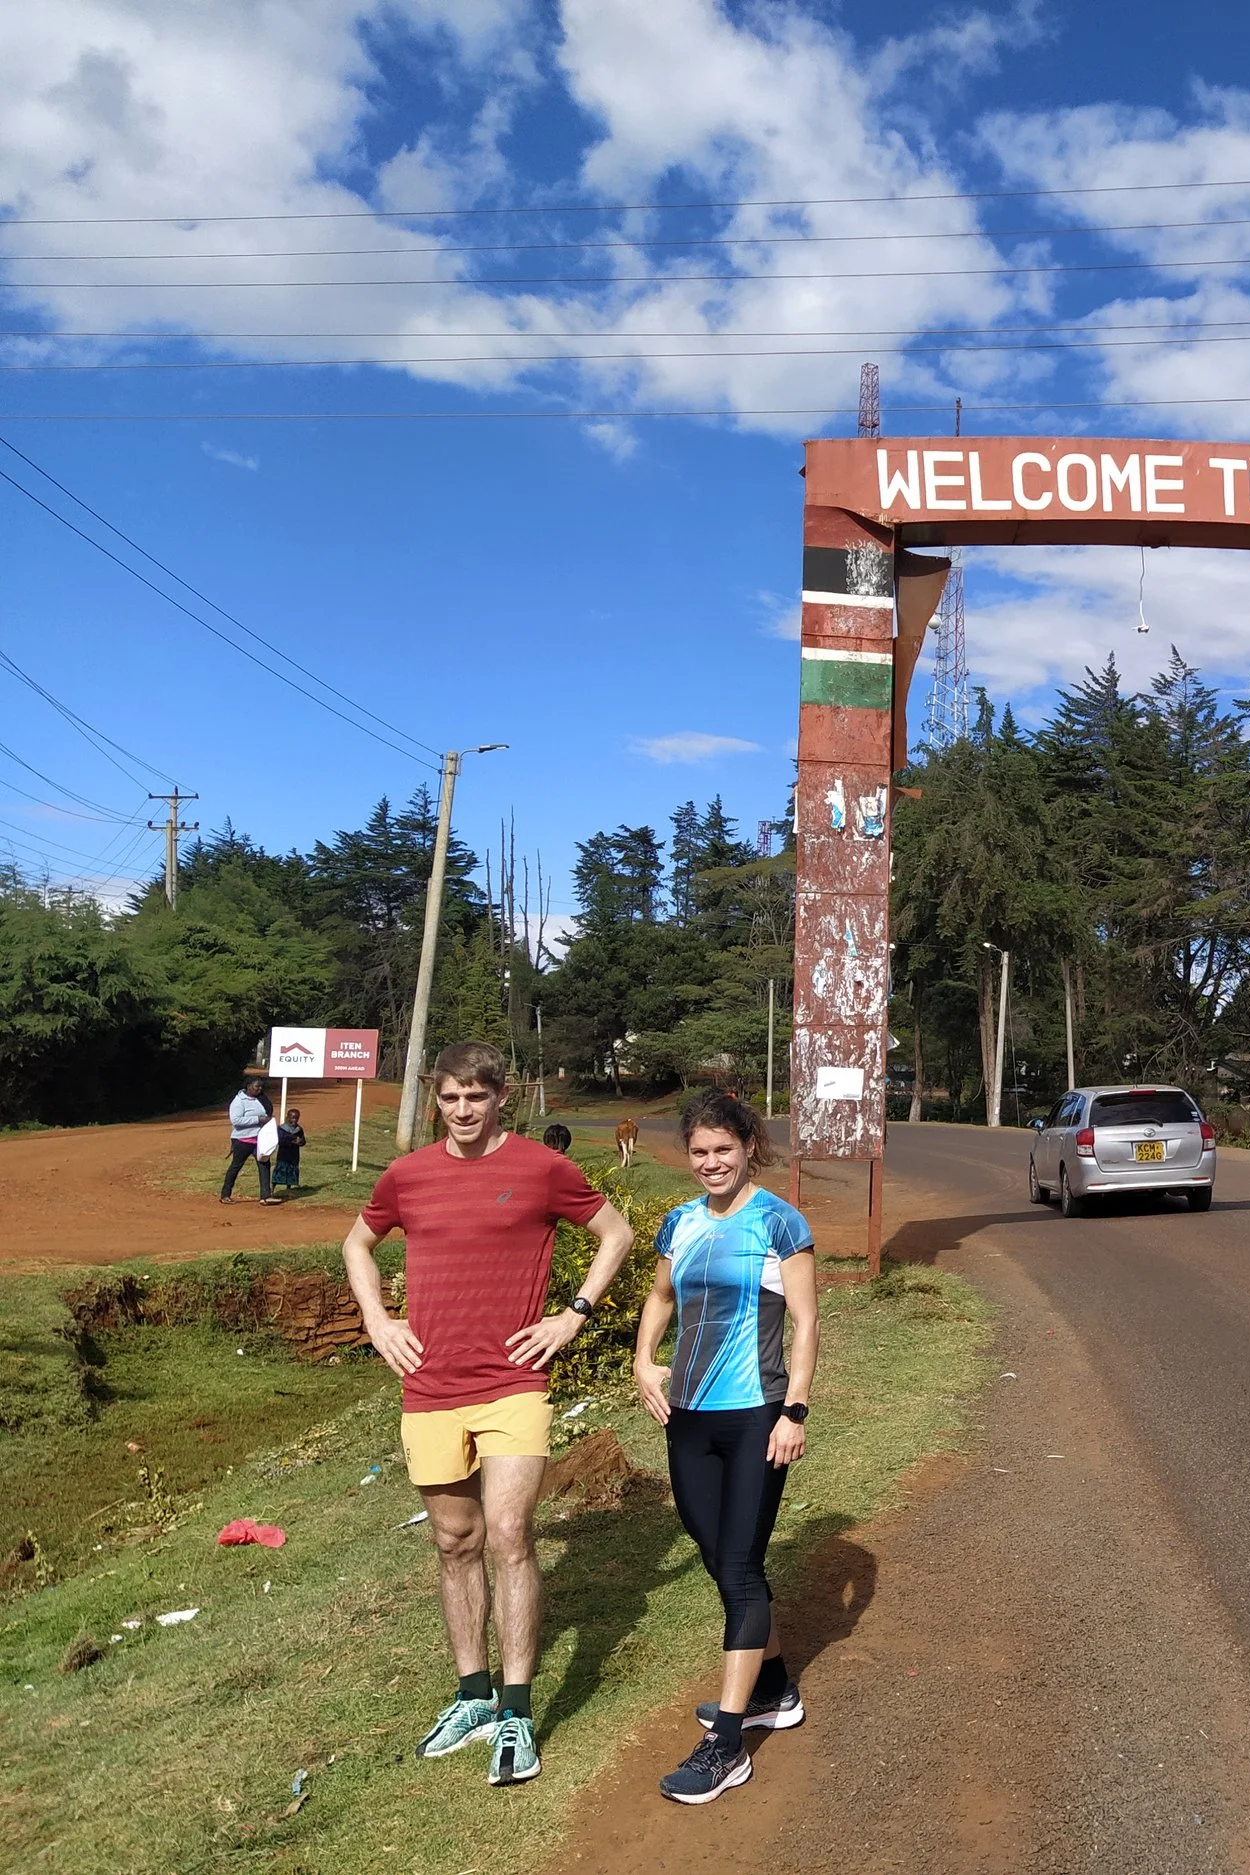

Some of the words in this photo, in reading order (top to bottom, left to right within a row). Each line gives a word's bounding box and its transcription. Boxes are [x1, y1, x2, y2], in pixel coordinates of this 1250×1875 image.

[876, 448, 1185, 514] WELCOME
[340, 1042, 362, 1050] ITEN
[331, 1050, 370, 1059] BRANCH
[279, 1055, 315, 1063] EQUITY
[1137, 1143, 1156, 1152] KCM
[1138, 1152, 1162, 1160] 224G
